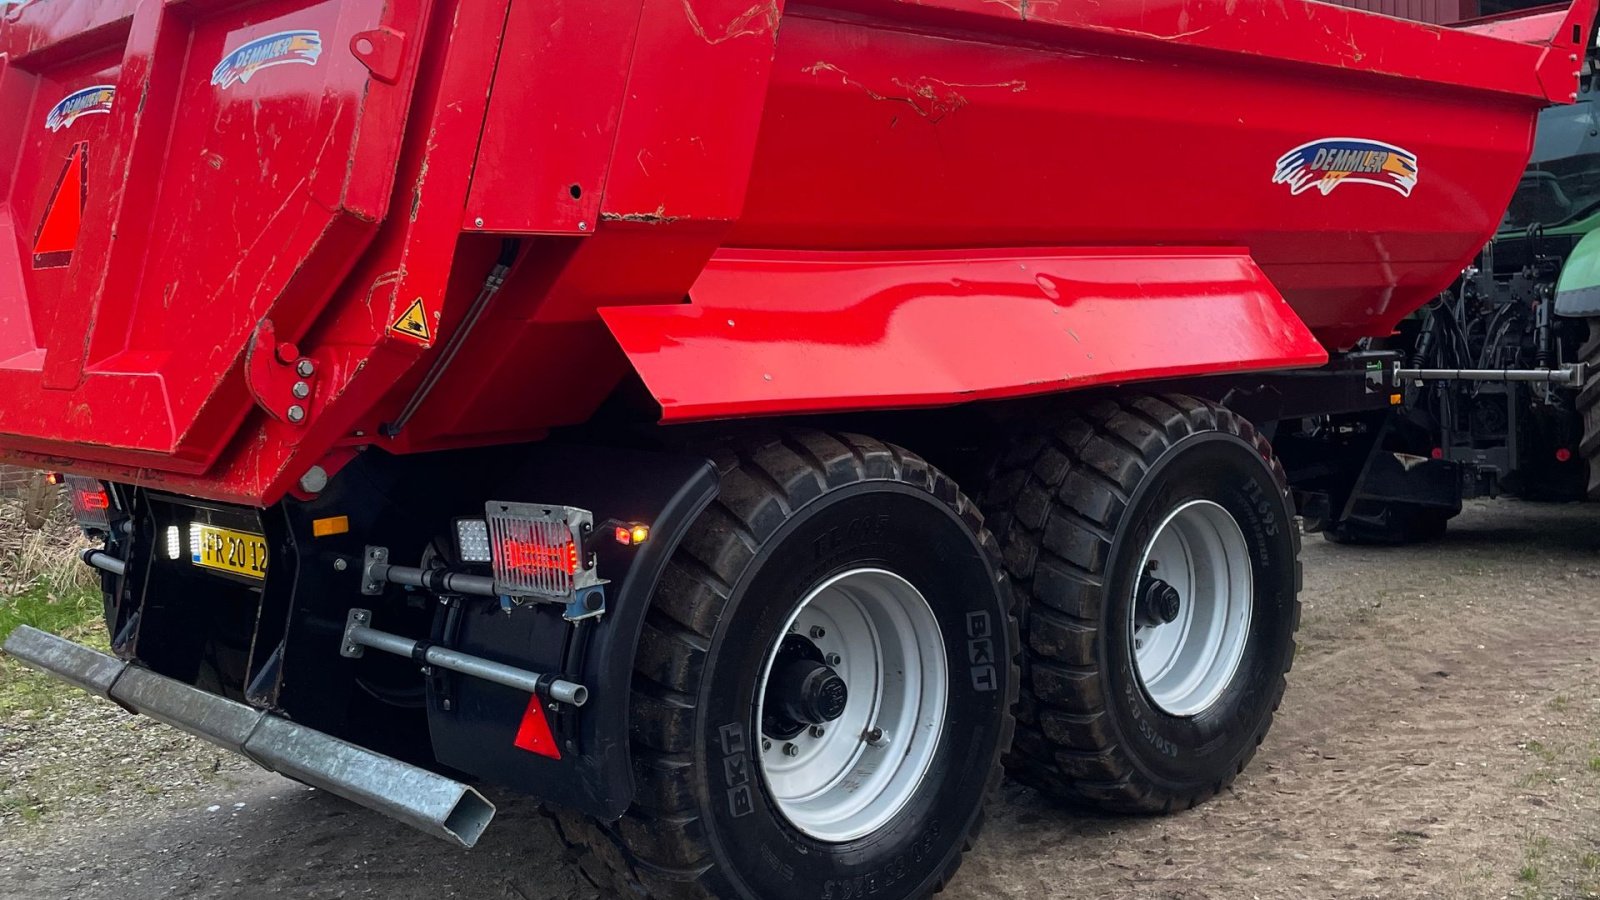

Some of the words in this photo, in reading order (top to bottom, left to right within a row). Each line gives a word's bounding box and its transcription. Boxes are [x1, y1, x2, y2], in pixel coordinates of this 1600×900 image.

[234, 36, 293, 69] DEMMLER
[1310, 147, 1389, 173] DEMMLER
[205, 531, 225, 564] FR
[227, 536, 246, 568] 20
[250, 540, 267, 572] 12
[966, 609, 997, 692] BKT
[718, 722, 754, 817] BKT
